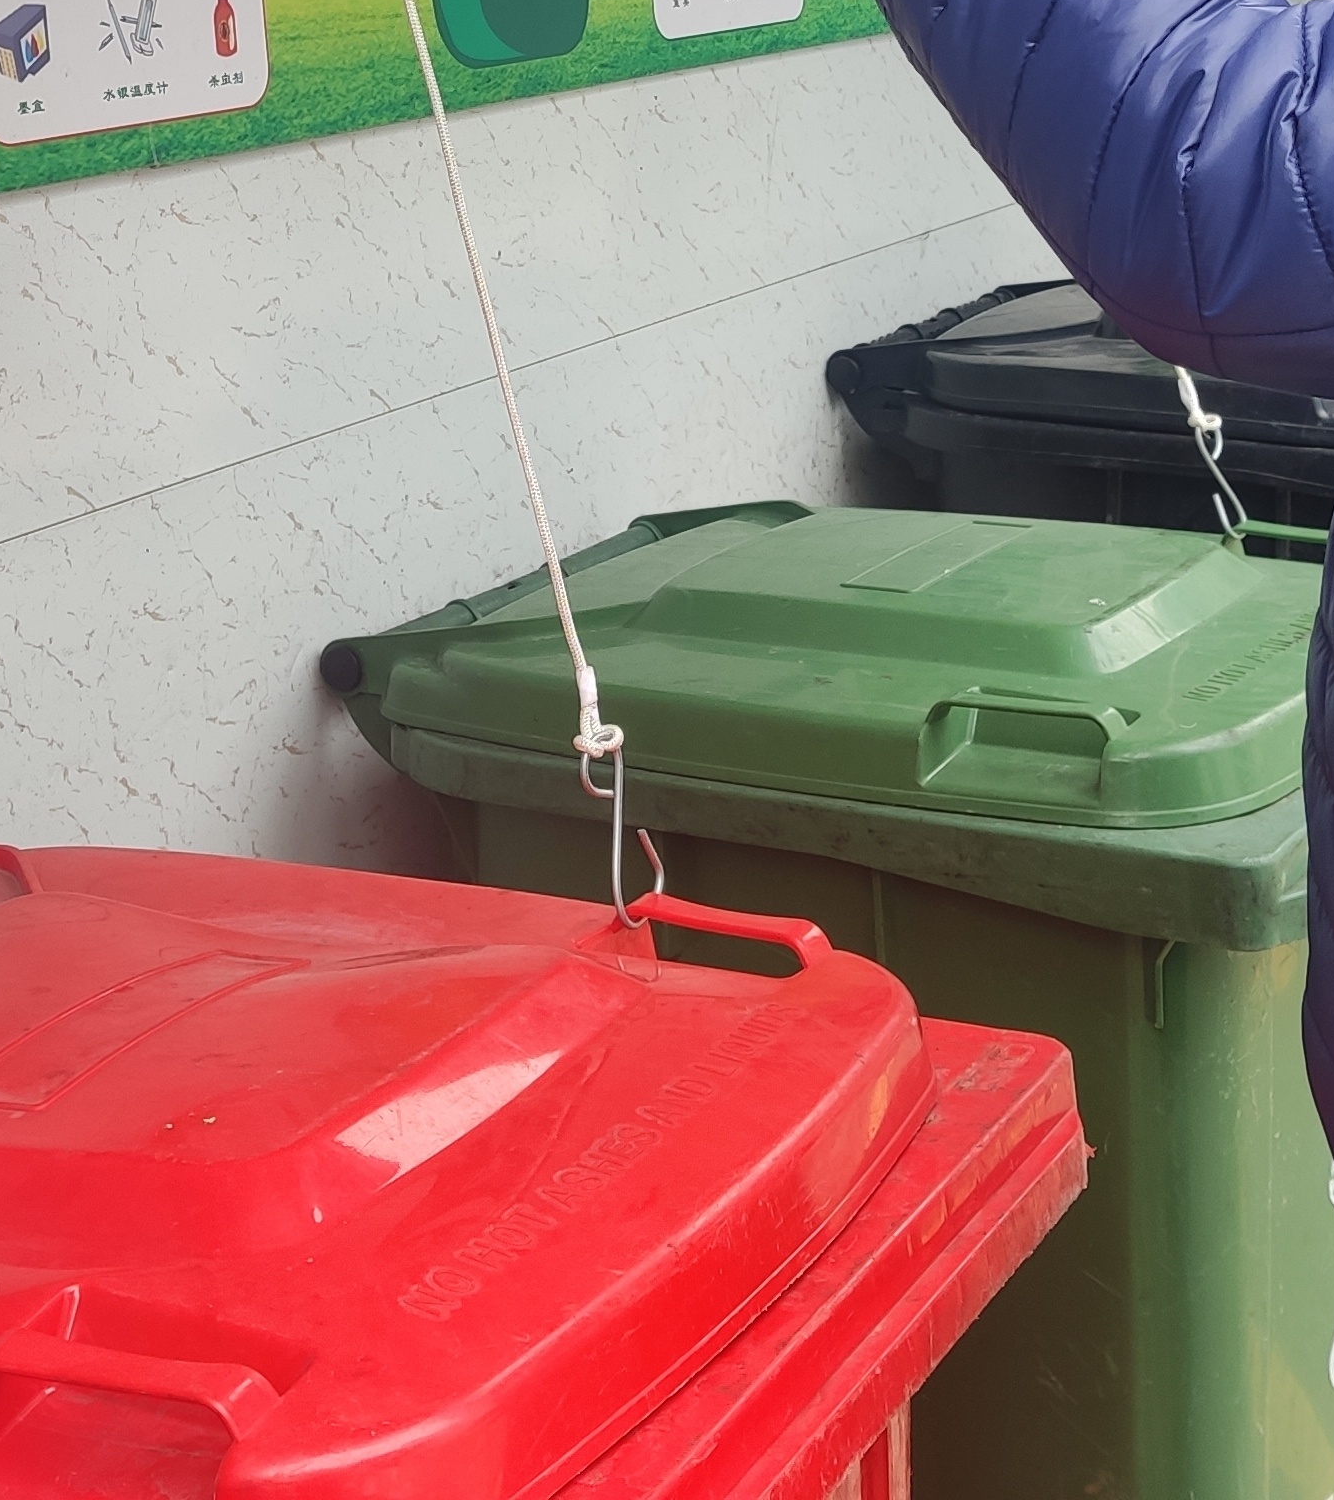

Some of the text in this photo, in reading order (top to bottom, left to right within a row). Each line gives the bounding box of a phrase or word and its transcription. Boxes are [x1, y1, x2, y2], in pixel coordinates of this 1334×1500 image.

[397, 1000, 807, 1322] NO HOT ASHES AND LIQUIDS
